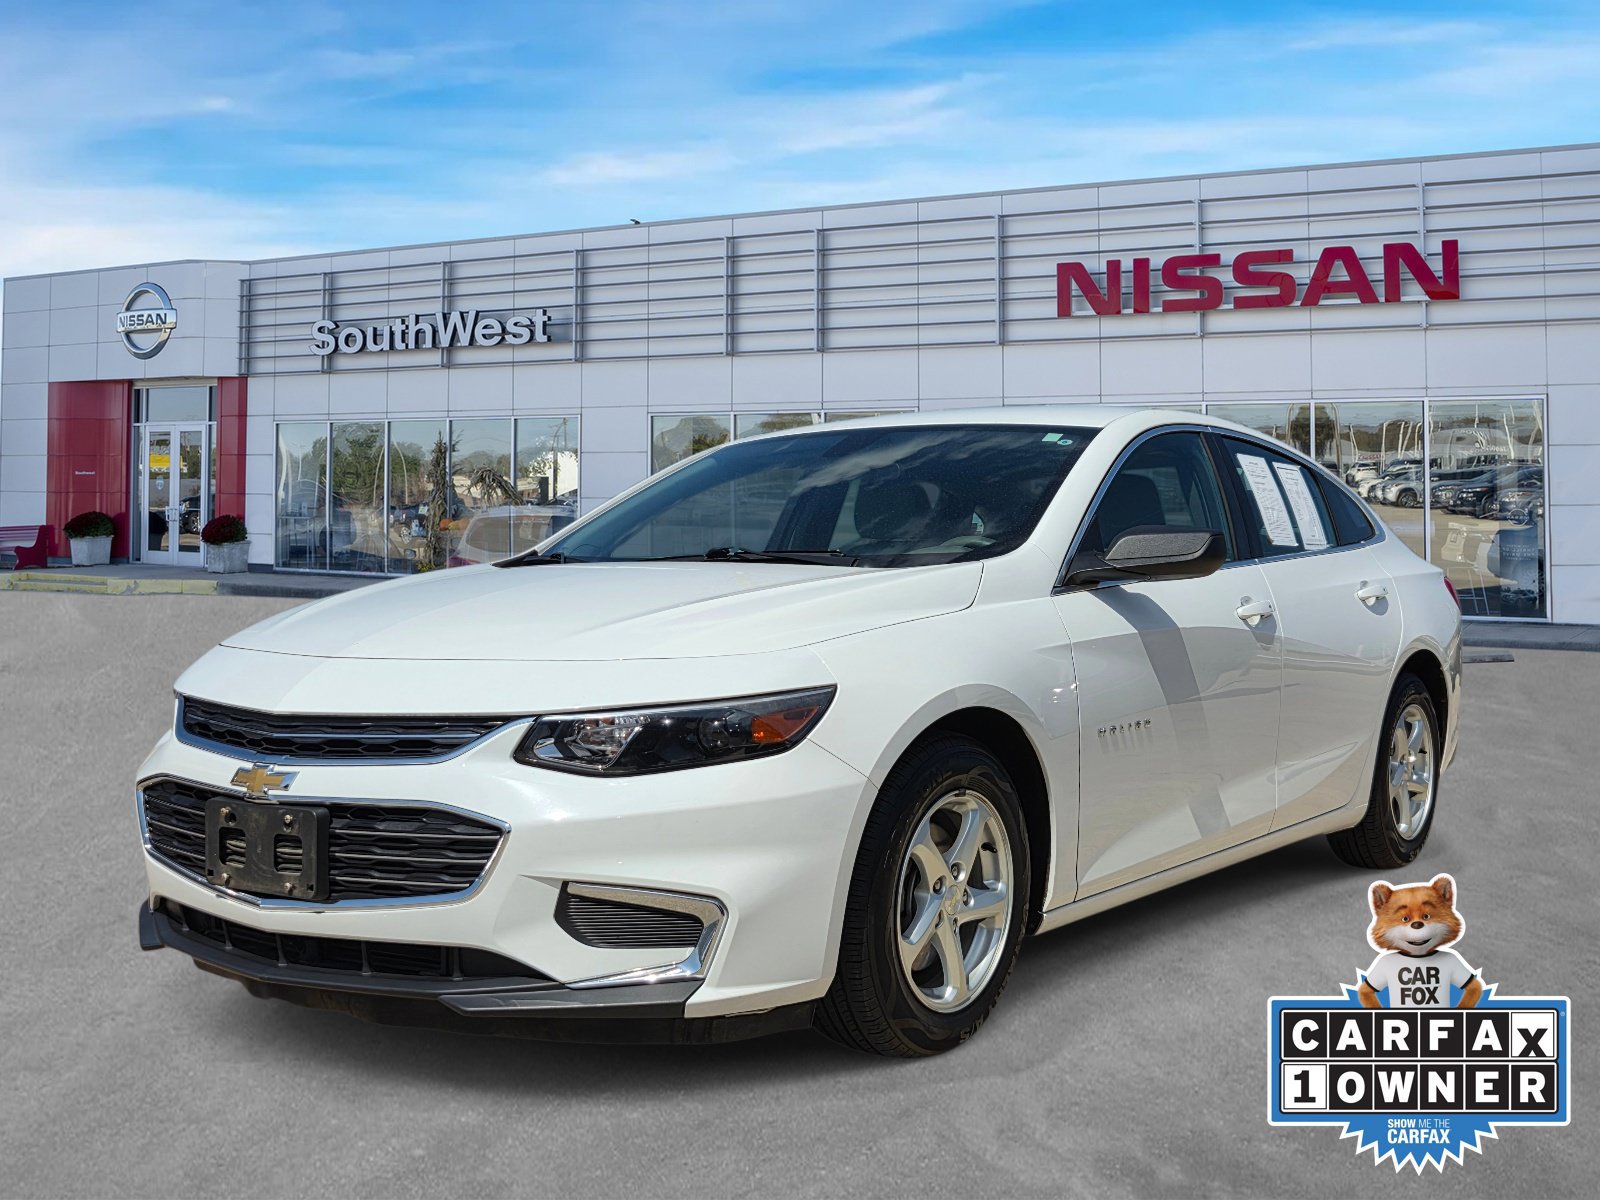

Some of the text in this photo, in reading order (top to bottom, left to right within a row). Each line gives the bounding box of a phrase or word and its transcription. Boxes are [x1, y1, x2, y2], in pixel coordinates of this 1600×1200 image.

[1056, 239, 1460, 318] NISSAN
[119, 312, 167, 328] NISSAN
[309, 308, 551, 356] SouthWest
